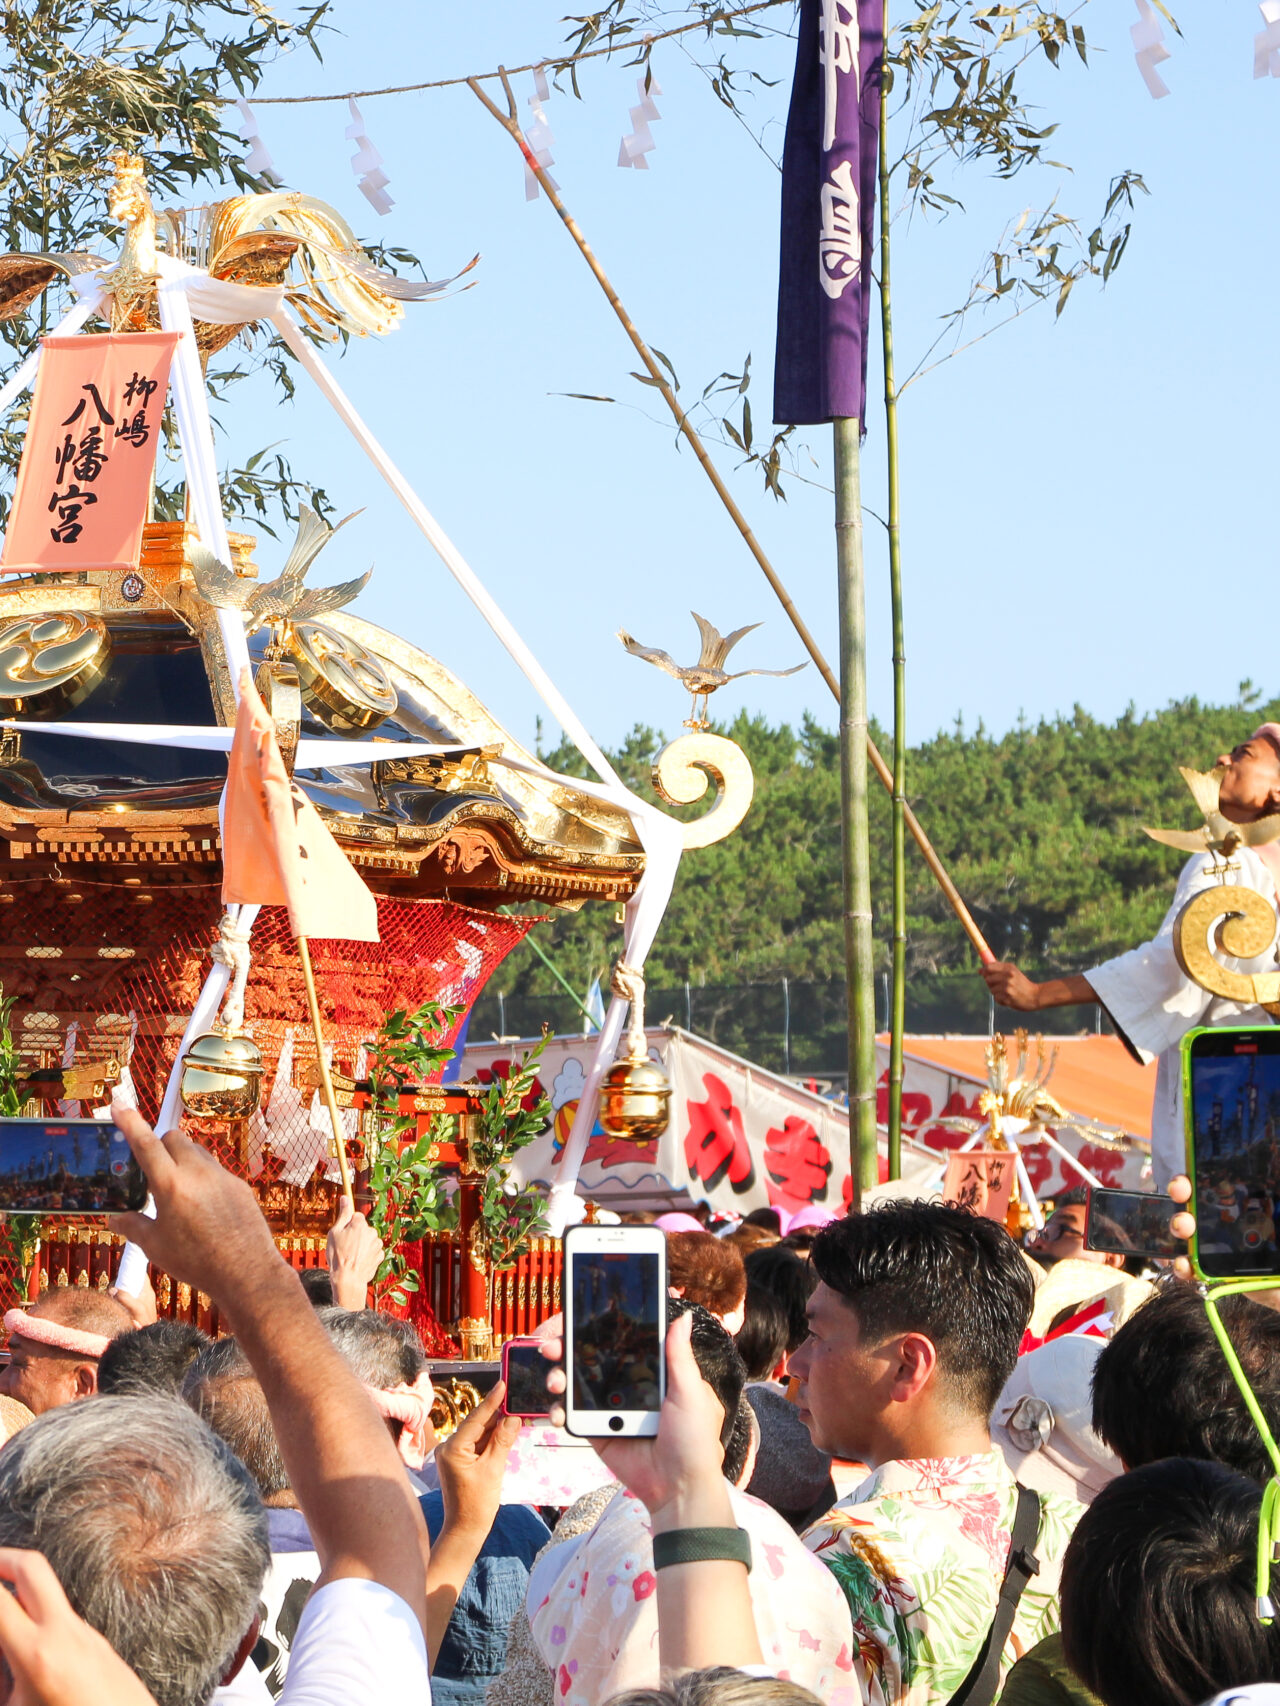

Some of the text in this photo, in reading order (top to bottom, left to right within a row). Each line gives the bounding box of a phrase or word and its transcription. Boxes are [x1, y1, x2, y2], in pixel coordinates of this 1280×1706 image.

[48, 383, 115, 543] 八幡宮
[114, 372, 158, 448] 柳嶋
